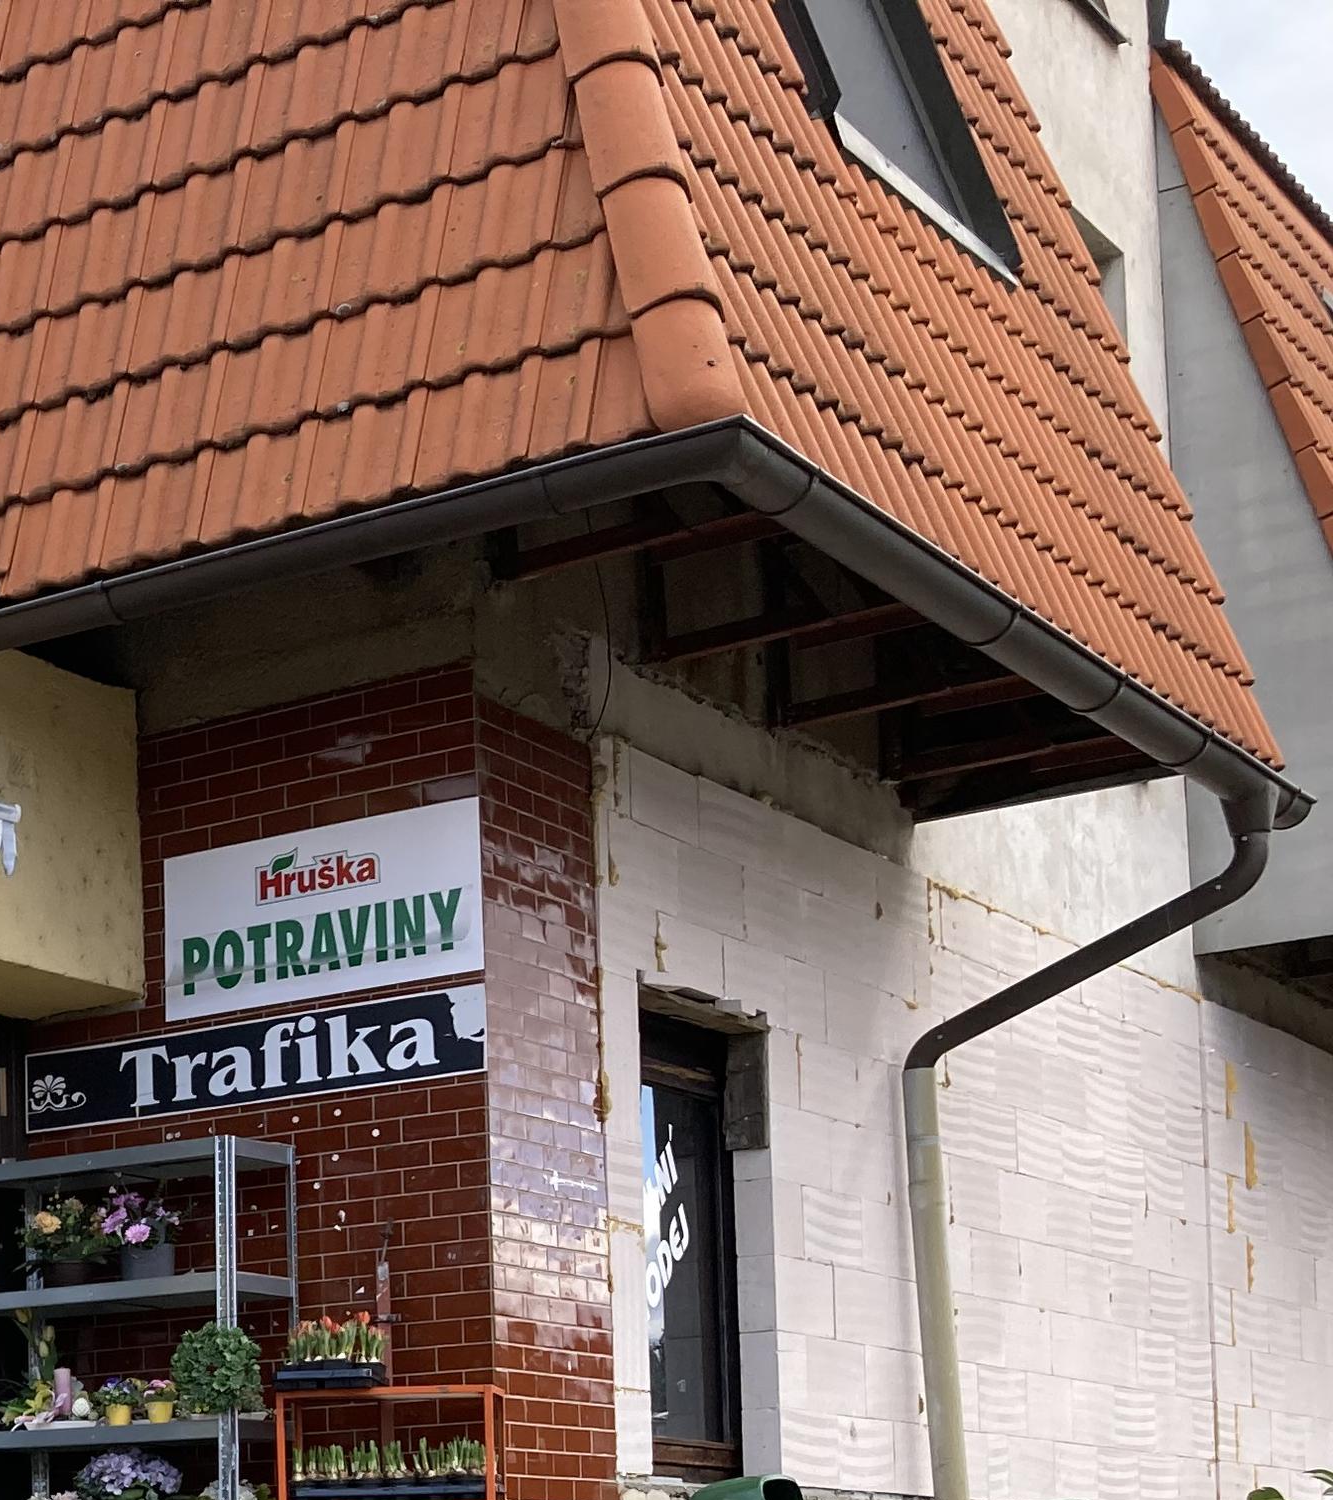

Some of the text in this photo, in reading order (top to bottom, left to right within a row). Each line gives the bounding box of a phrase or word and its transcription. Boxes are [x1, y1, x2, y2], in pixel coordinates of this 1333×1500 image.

[259, 854, 377, 901] Hruška
[182, 887, 462, 996] POTRAVINY
[119, 1014, 440, 1108] Trafika
